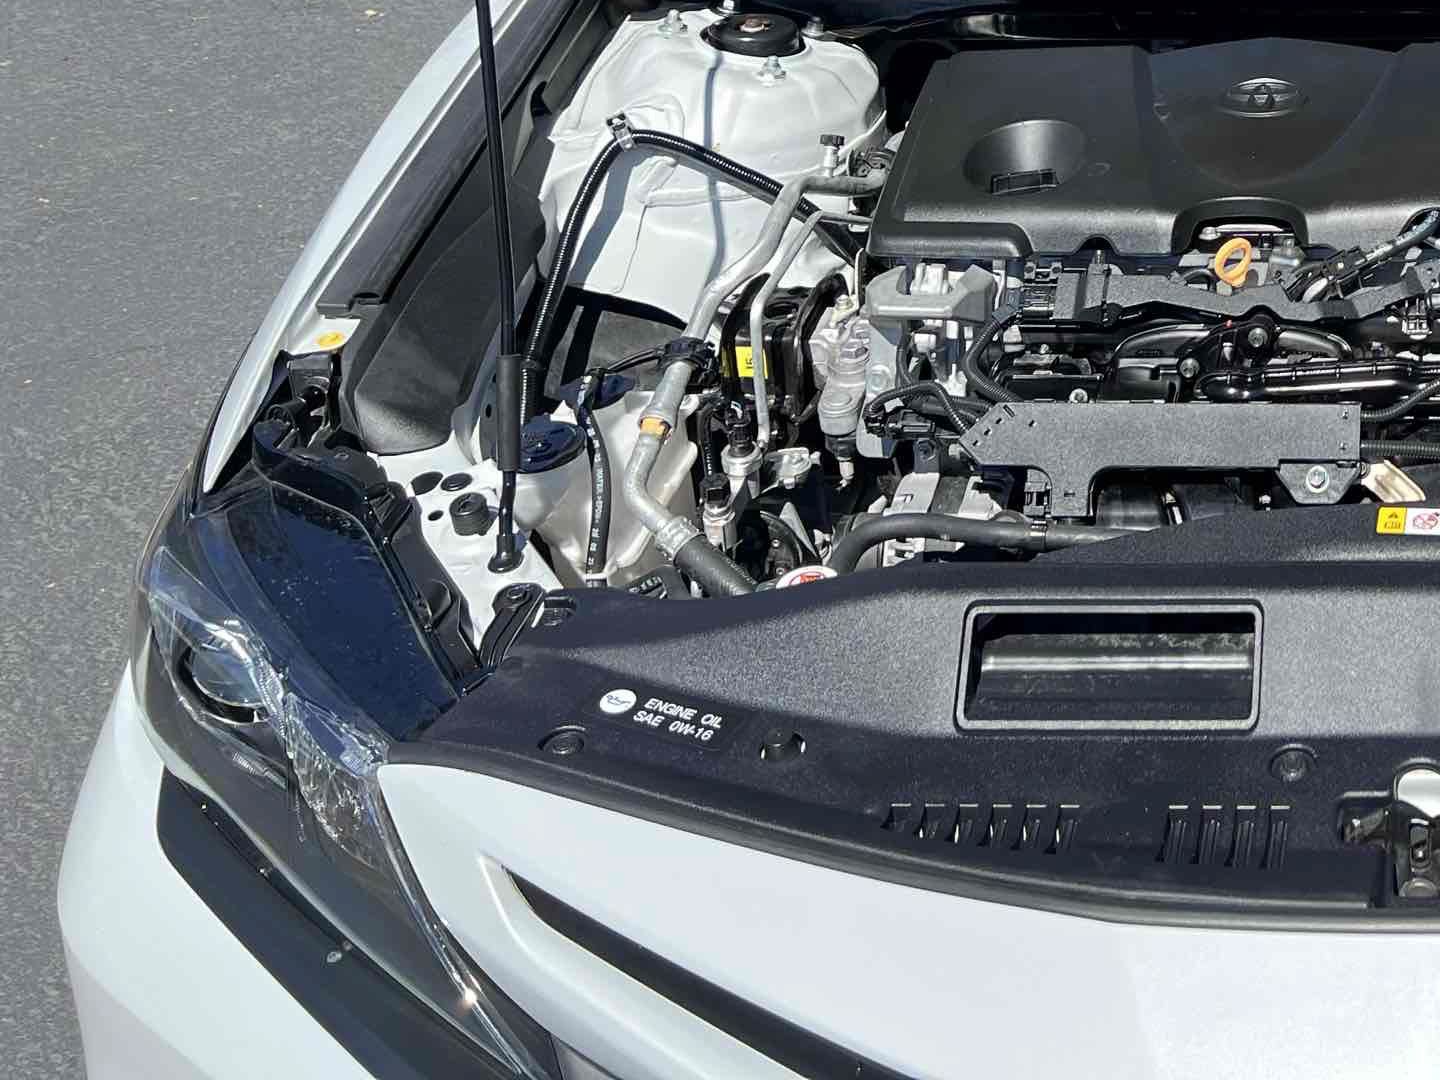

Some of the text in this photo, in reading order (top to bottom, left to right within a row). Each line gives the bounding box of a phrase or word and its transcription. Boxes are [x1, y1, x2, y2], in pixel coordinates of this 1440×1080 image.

[633, 710, 714, 741] SAE 0W-16
[644, 697, 723, 728] ENGINE OIL
